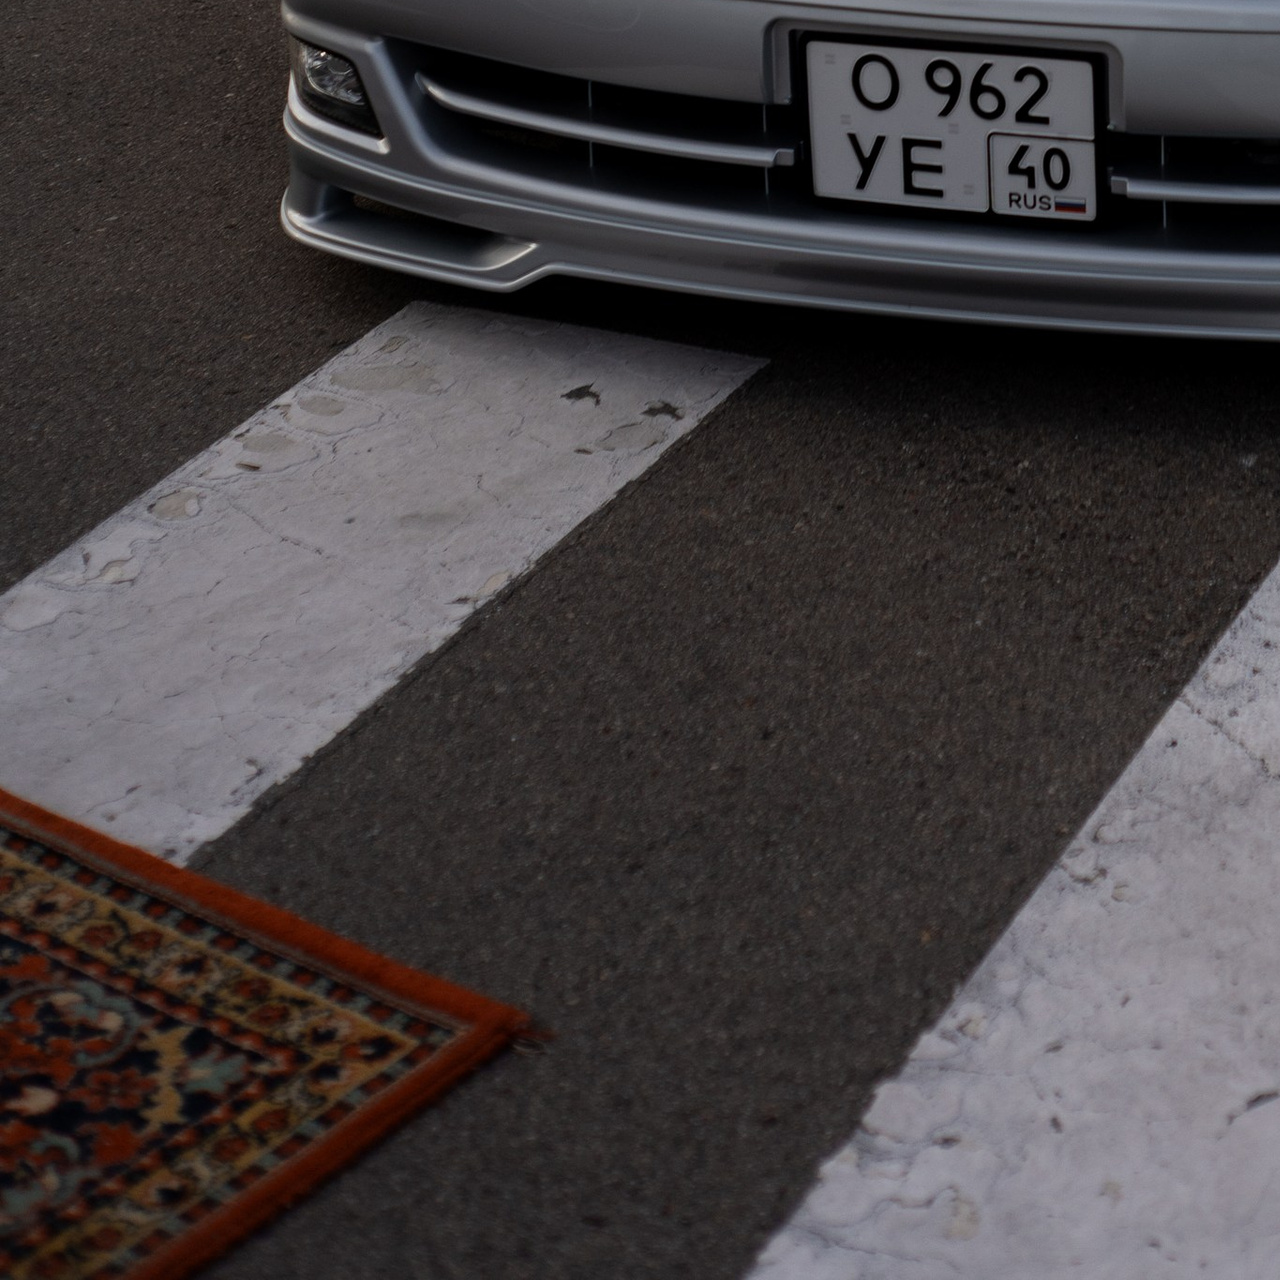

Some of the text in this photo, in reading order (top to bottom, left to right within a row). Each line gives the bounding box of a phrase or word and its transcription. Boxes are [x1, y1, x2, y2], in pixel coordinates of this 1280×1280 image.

[925, 59, 1051, 125] 962
[847, 133, 944, 198] УЕ
[1007, 144, 1071, 191] 40
[1008, 192, 1052, 211] RUS
